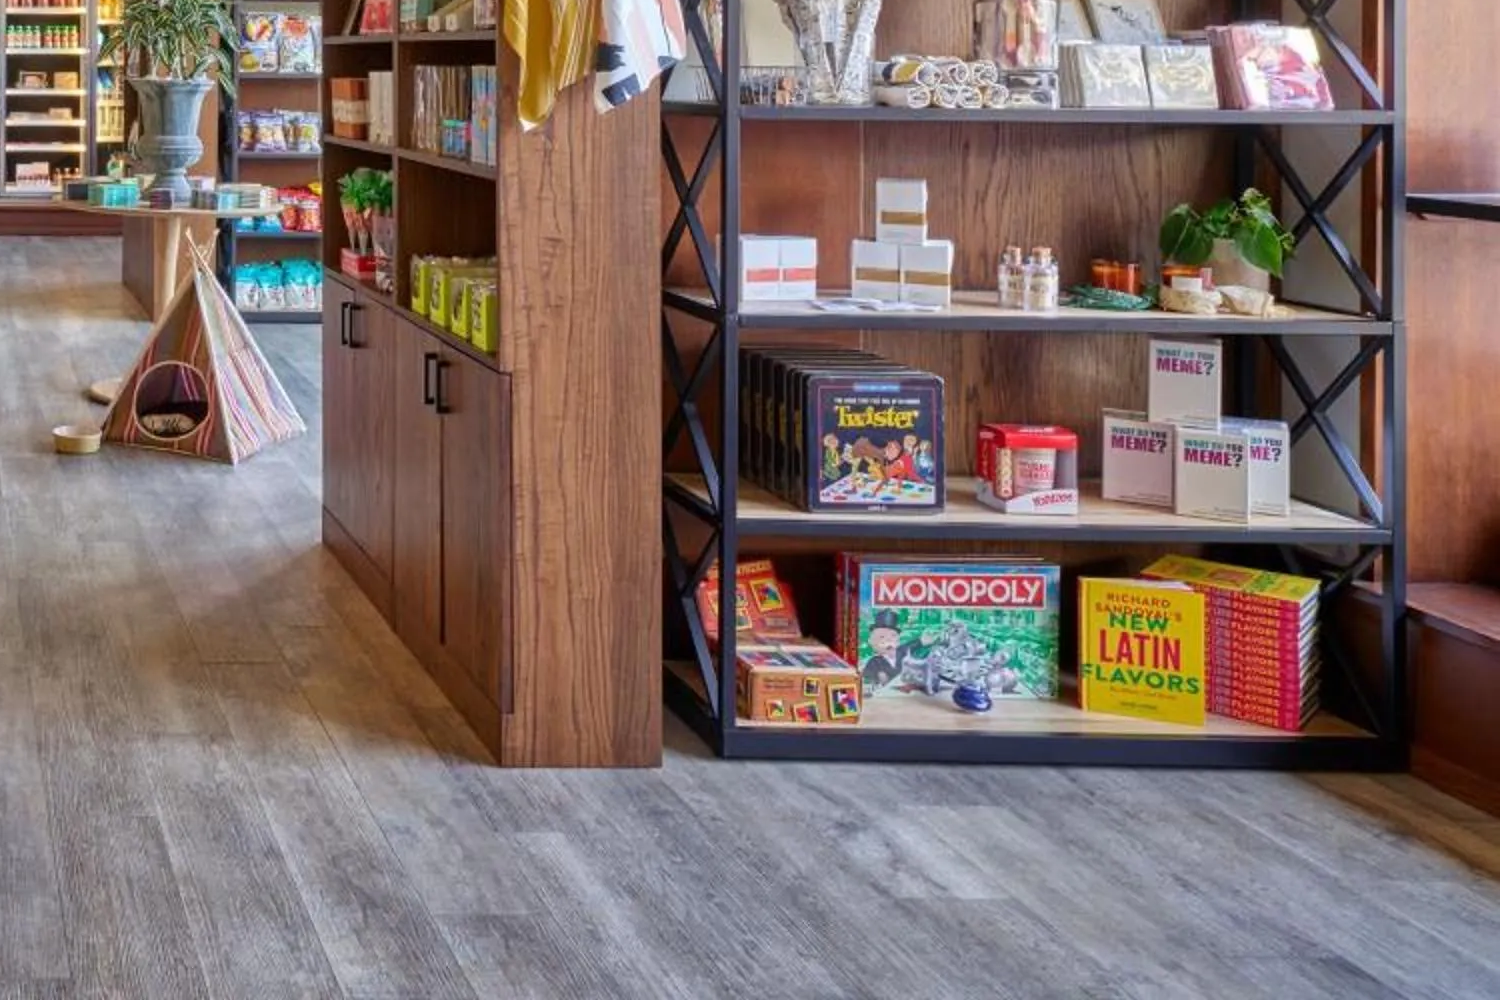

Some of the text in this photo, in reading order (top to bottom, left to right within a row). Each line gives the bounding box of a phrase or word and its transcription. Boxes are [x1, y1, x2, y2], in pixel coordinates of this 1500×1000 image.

[1156, 357, 1214, 375] MEME?
[834, 405, 918, 429] Twister
[1111, 435, 1167, 453] MEME?
[1250, 445, 1281, 462] ME?
[1183, 448, 1243, 467] MEME?
[879, 578, 1041, 604] MONOPOLY
[1106, 592, 1171, 609] RICHARD
[1109, 611, 1168, 632] NEW
[1100, 629, 1180, 672] LATIN
[1082, 663, 1199, 694] FLAVORS
